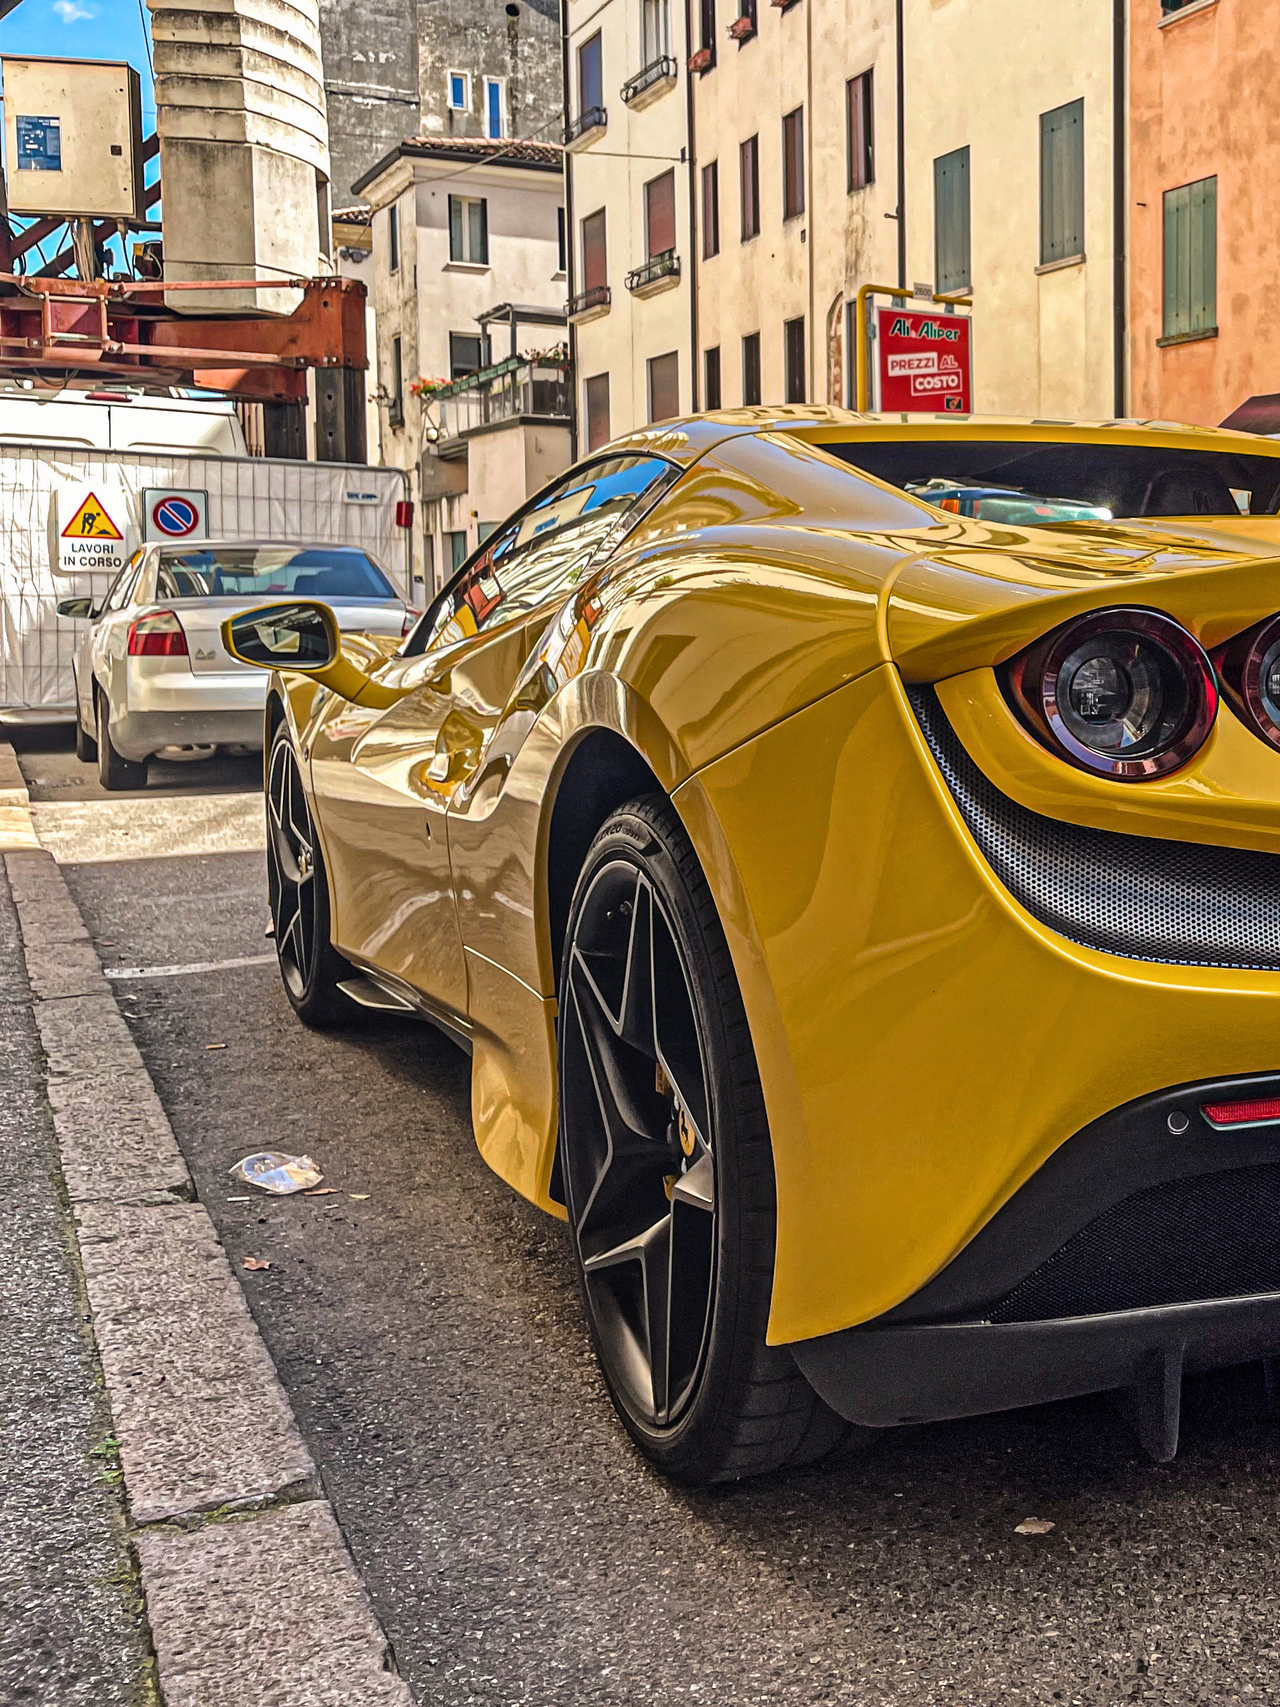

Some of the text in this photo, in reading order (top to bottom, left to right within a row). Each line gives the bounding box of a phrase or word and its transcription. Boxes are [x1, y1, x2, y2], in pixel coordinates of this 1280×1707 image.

[889, 318, 960, 341] Ali Aliper
[891, 355, 958, 371] PREZZI AL
[915, 374, 959, 390] COSTO
[71, 543, 114, 554] LAVORI
[63, 556, 122, 567] IN CORSO
